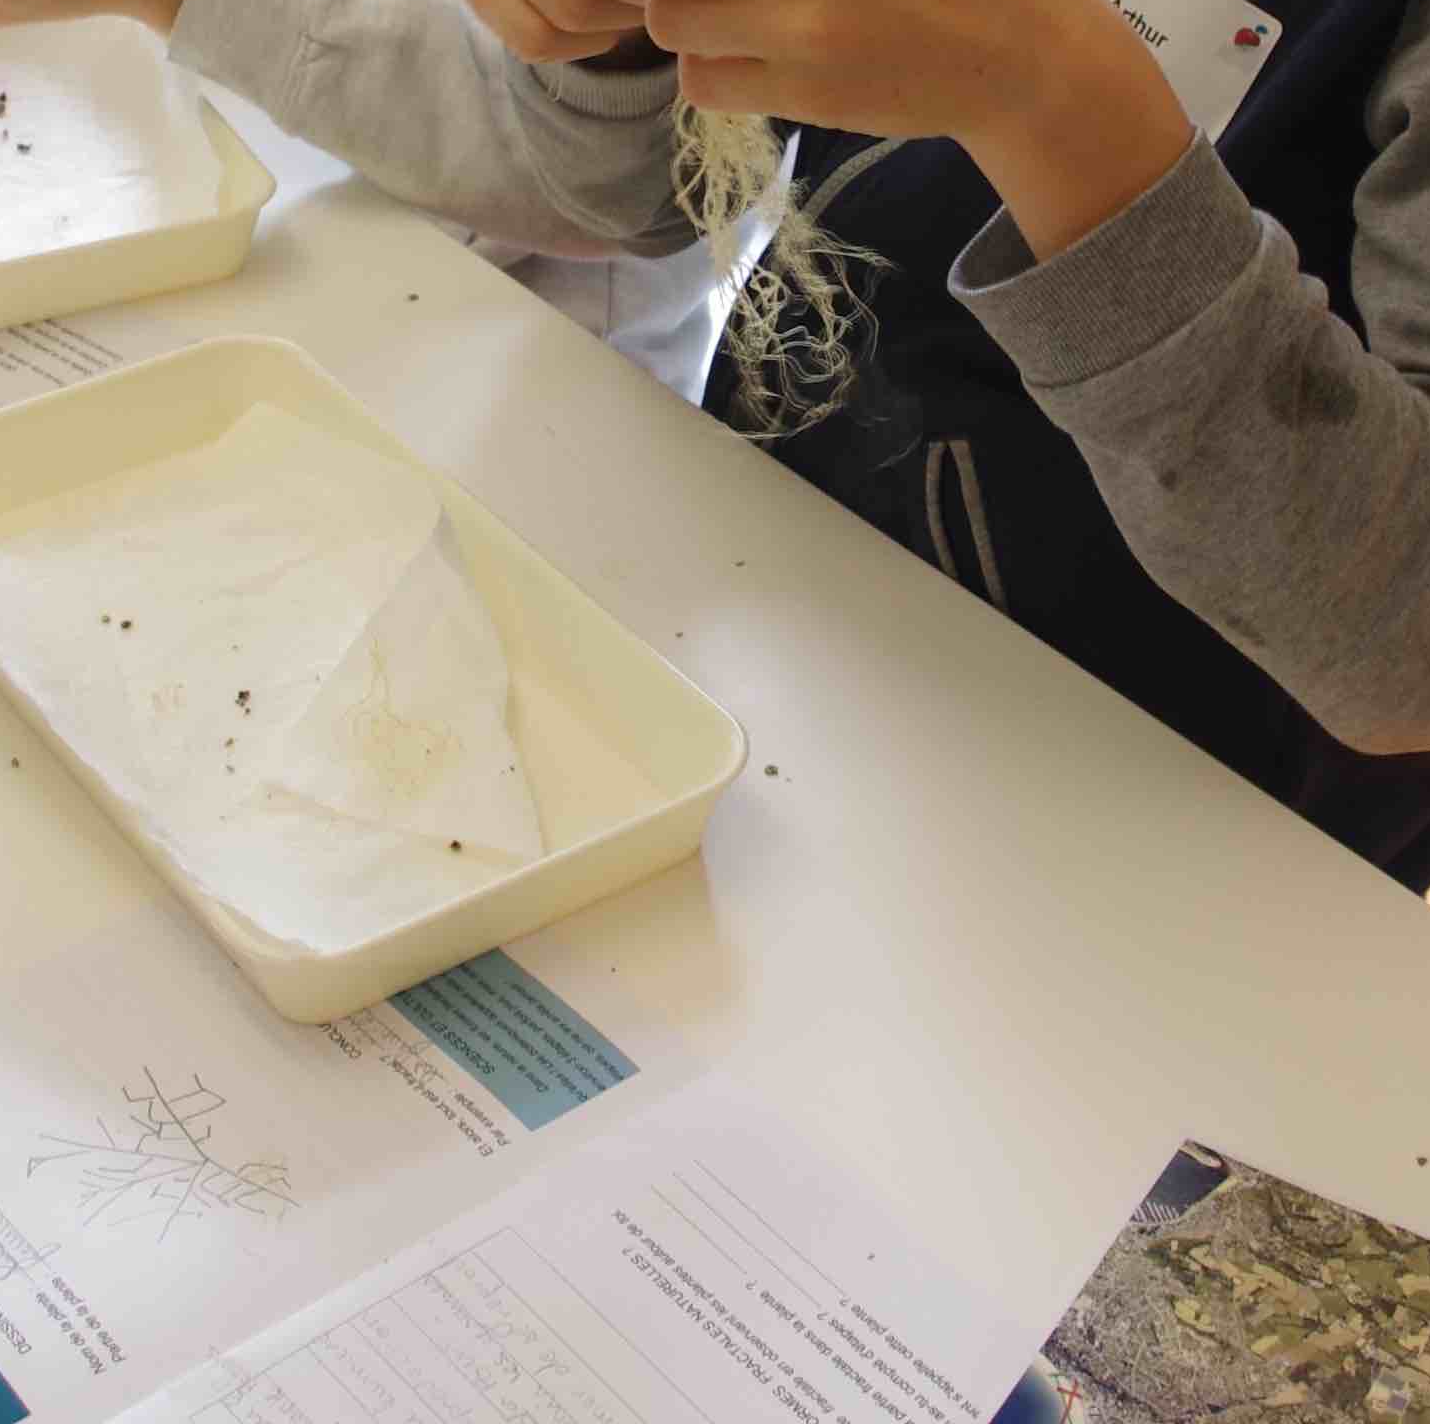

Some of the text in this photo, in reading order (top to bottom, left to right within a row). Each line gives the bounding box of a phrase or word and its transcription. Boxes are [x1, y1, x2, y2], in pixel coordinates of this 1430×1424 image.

[623, 1220, 645, 1238] de
[625, 1252, 709, 1322] NATURELLES
[668, 1263, 716, 1302] plantes
[755, 1288, 797, 1322] plante
[846, 1302, 889, 1337] plante
[721, 1312, 782, 1363] observant
[788, 1319, 807, 1333] la
[799, 1329, 835, 1358] dans
[697, 1319, 776, 1384] FRACTALES
[879, 1332, 916, 1362] cette
[826, 1353, 876, 1393] fractale
[768, 1383, 824, 1424] ORMES
